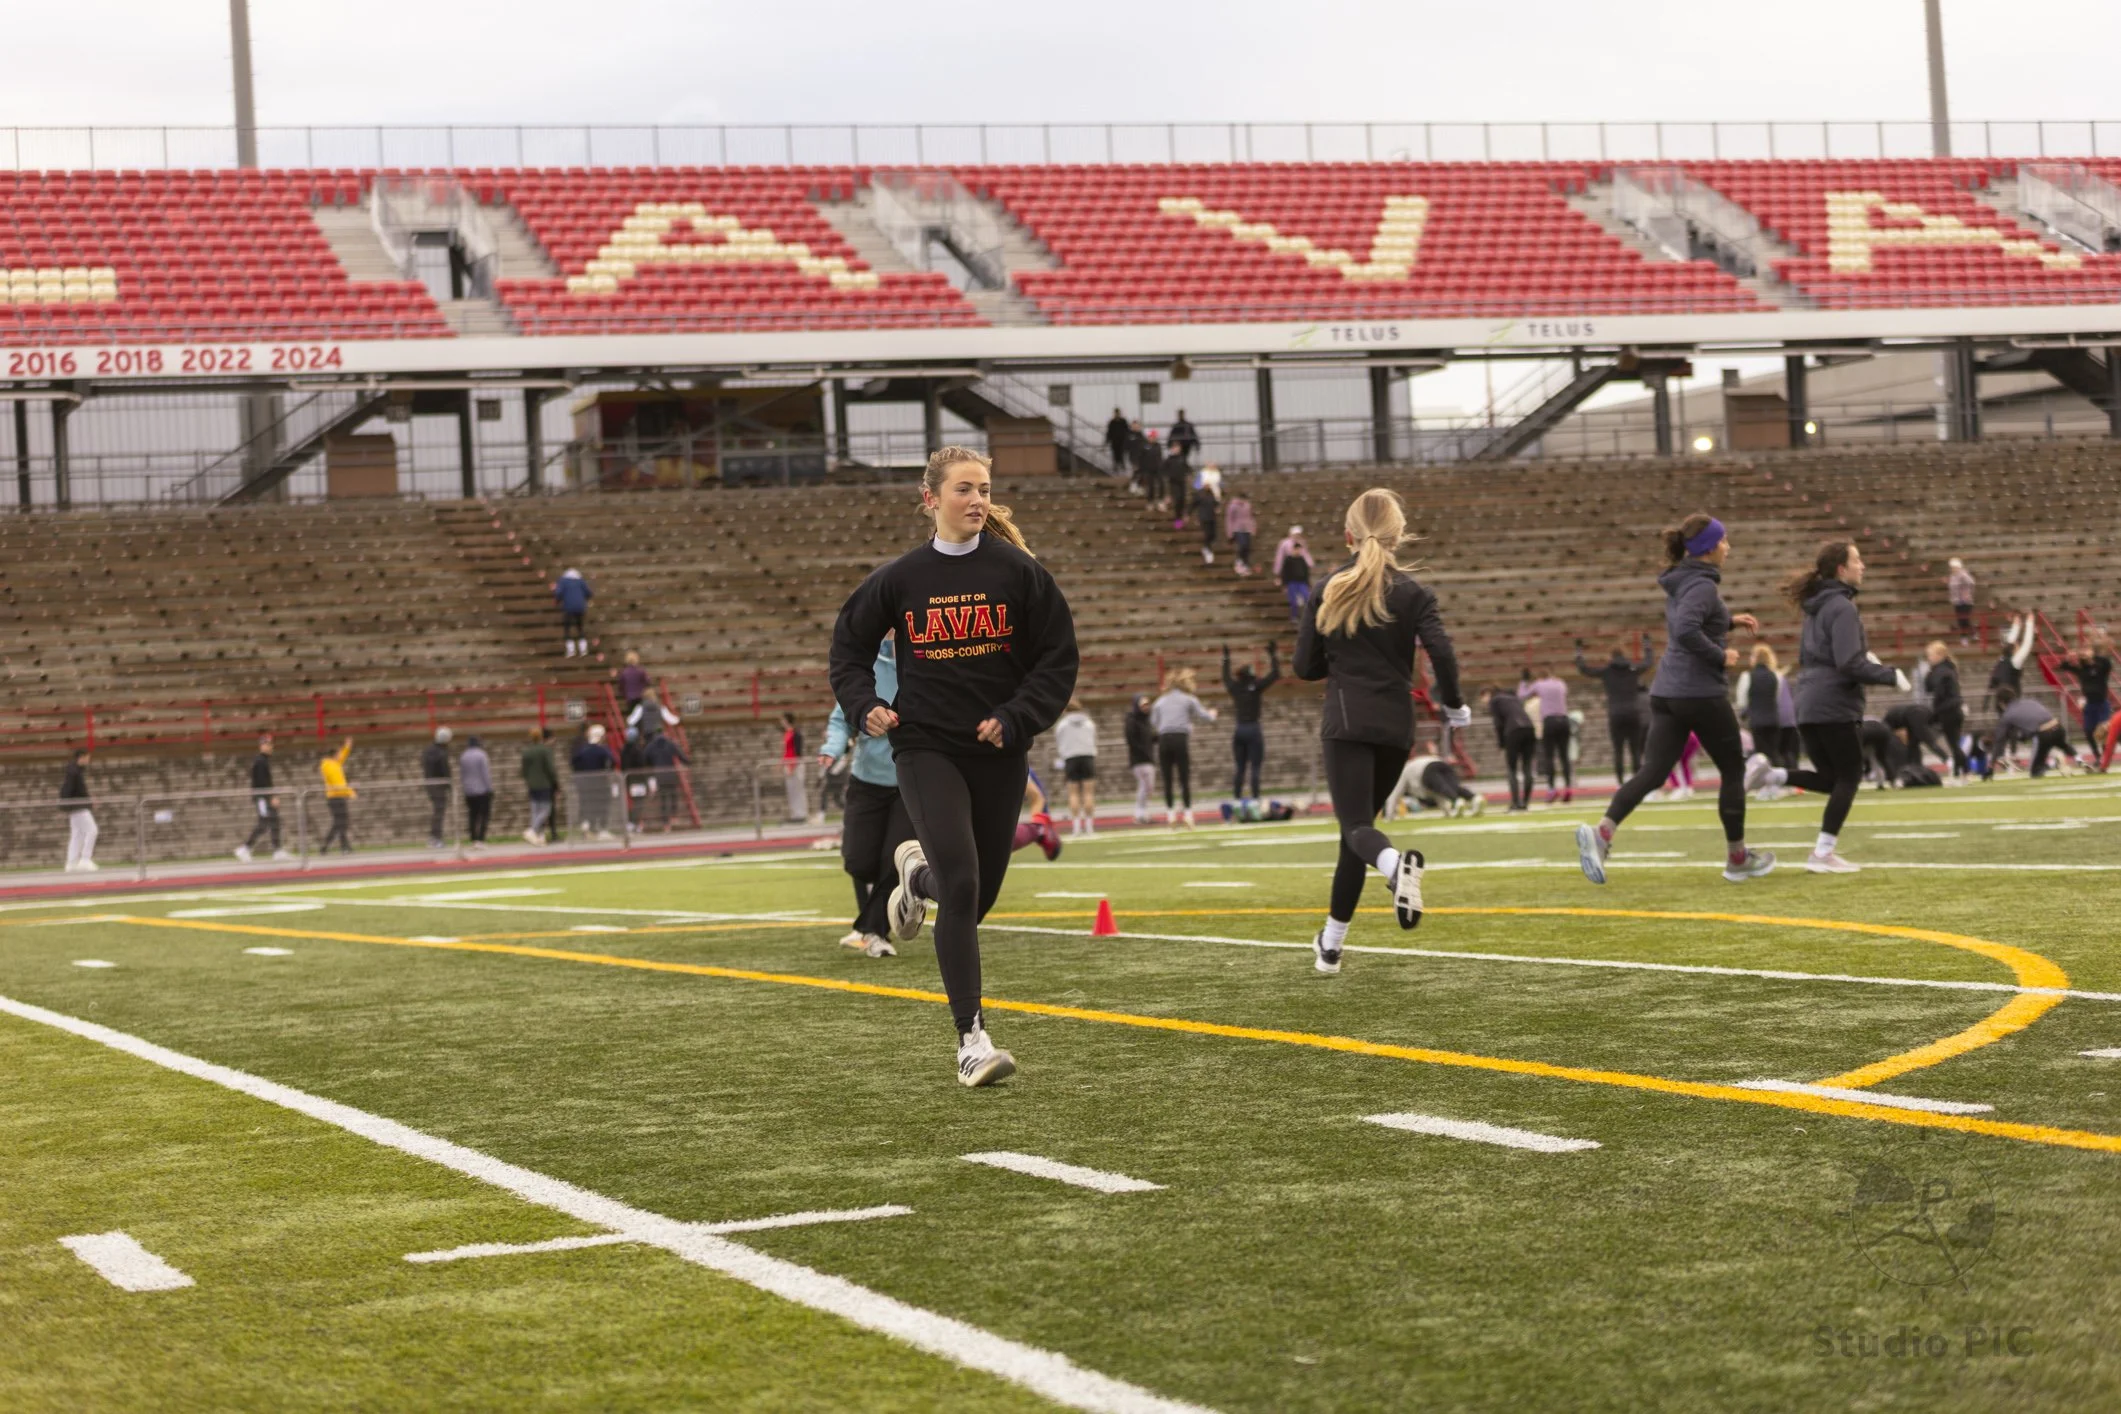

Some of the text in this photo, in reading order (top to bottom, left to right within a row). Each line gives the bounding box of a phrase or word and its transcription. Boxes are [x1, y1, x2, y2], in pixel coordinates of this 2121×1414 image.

[1331, 326, 1400, 342] TELUS
[1528, 322, 1595, 338] TELUS
[8, 345, 343, 376] 2016 2018 2022 2024
[929, 593, 987, 604] ROUGE ET OR
[905, 604, 1013, 643] LAVAL
[925, 643, 1003, 660] CROSS-COUNTRY
